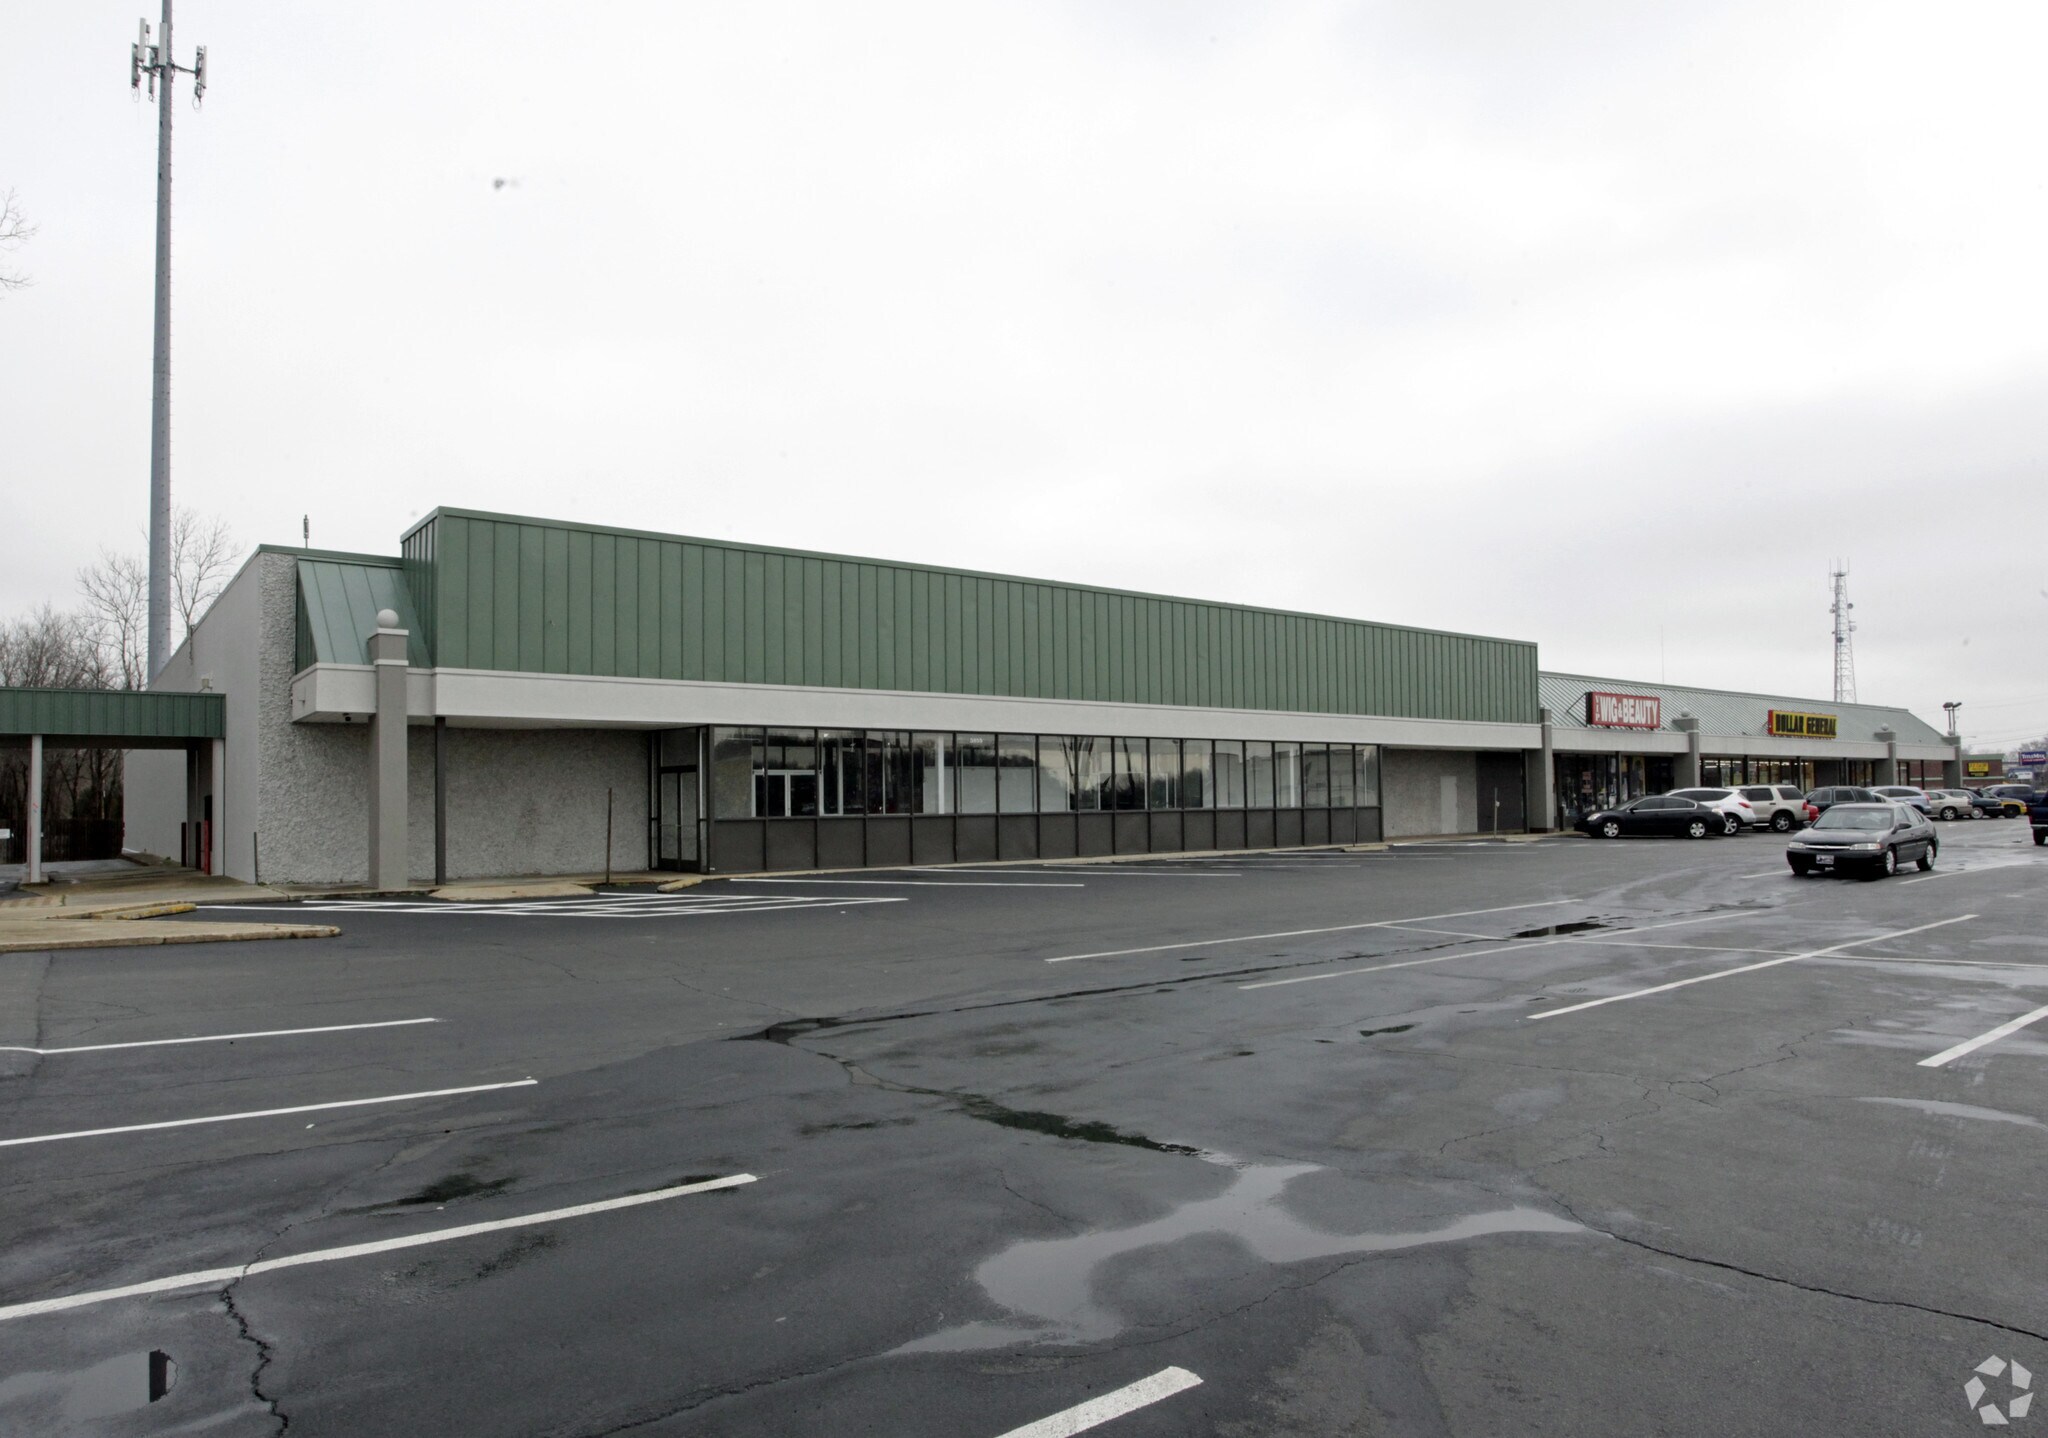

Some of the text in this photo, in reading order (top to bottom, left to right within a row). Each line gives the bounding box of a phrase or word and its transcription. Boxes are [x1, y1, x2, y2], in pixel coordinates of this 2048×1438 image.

[1600, 696, 1658, 724] WIG & BEAUTY
[1807, 717, 1836, 735] GENERAL
